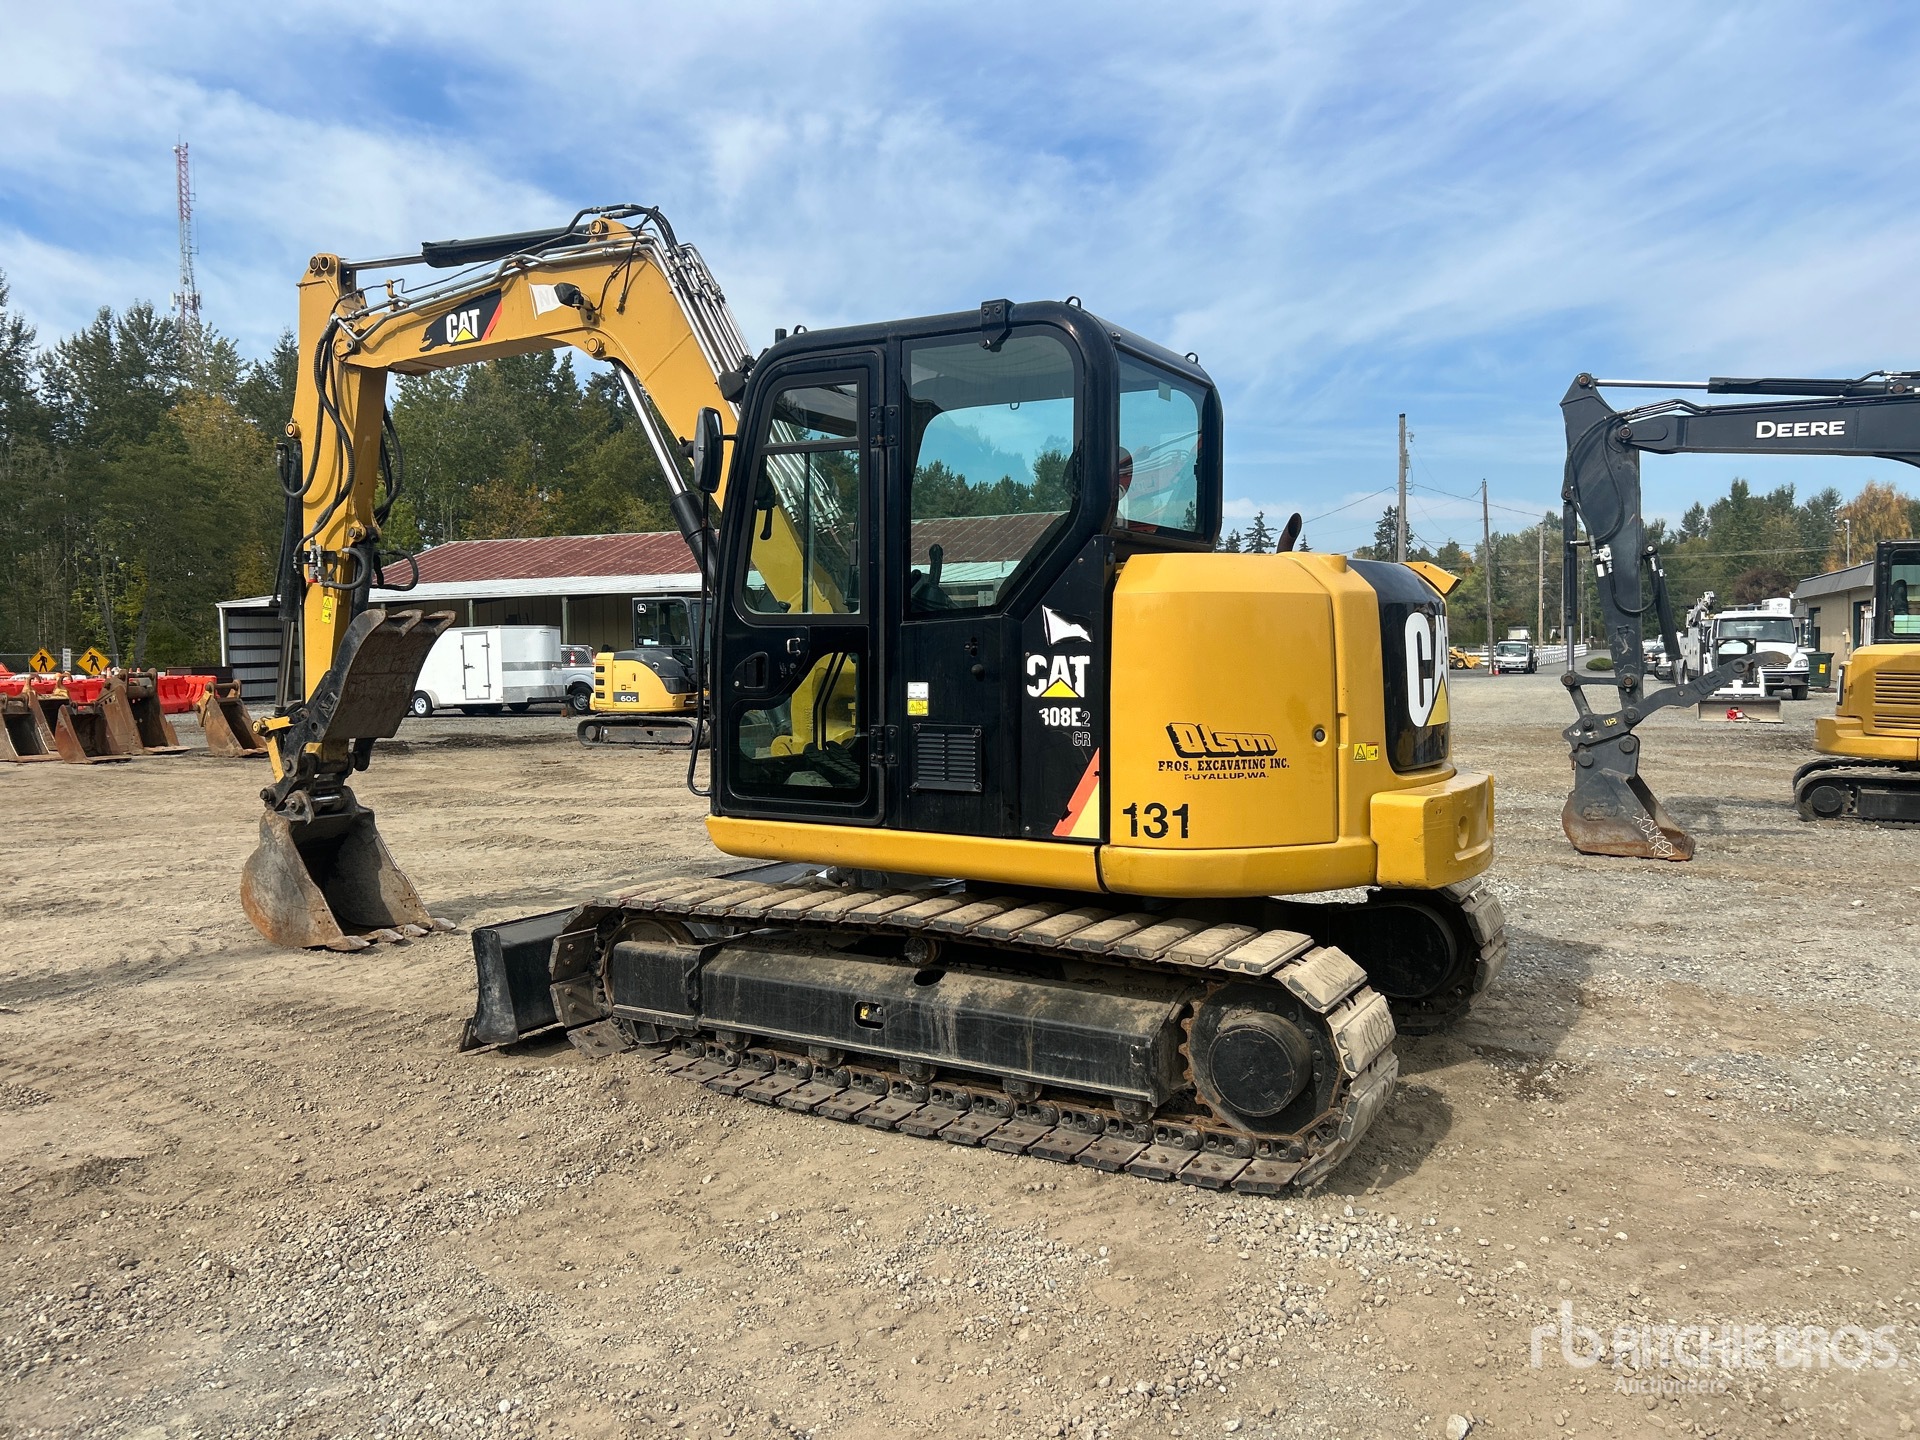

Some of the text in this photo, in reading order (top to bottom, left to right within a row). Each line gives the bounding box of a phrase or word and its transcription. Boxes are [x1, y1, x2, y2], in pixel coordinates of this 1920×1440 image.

[446, 309, 480, 343] CAT
[1756, 420, 1846, 438] DEERE
[1026, 654, 1091, 698] CAT
[1405, 612, 1448, 727] CA
[1072, 731, 1091, 746] CR
[1165, 722, 1278, 758] Olson
[1197, 759, 1266, 771] EXCAVATING
[1269, 757, 1291, 769] INC.
[1122, 802, 1189, 839] 131
